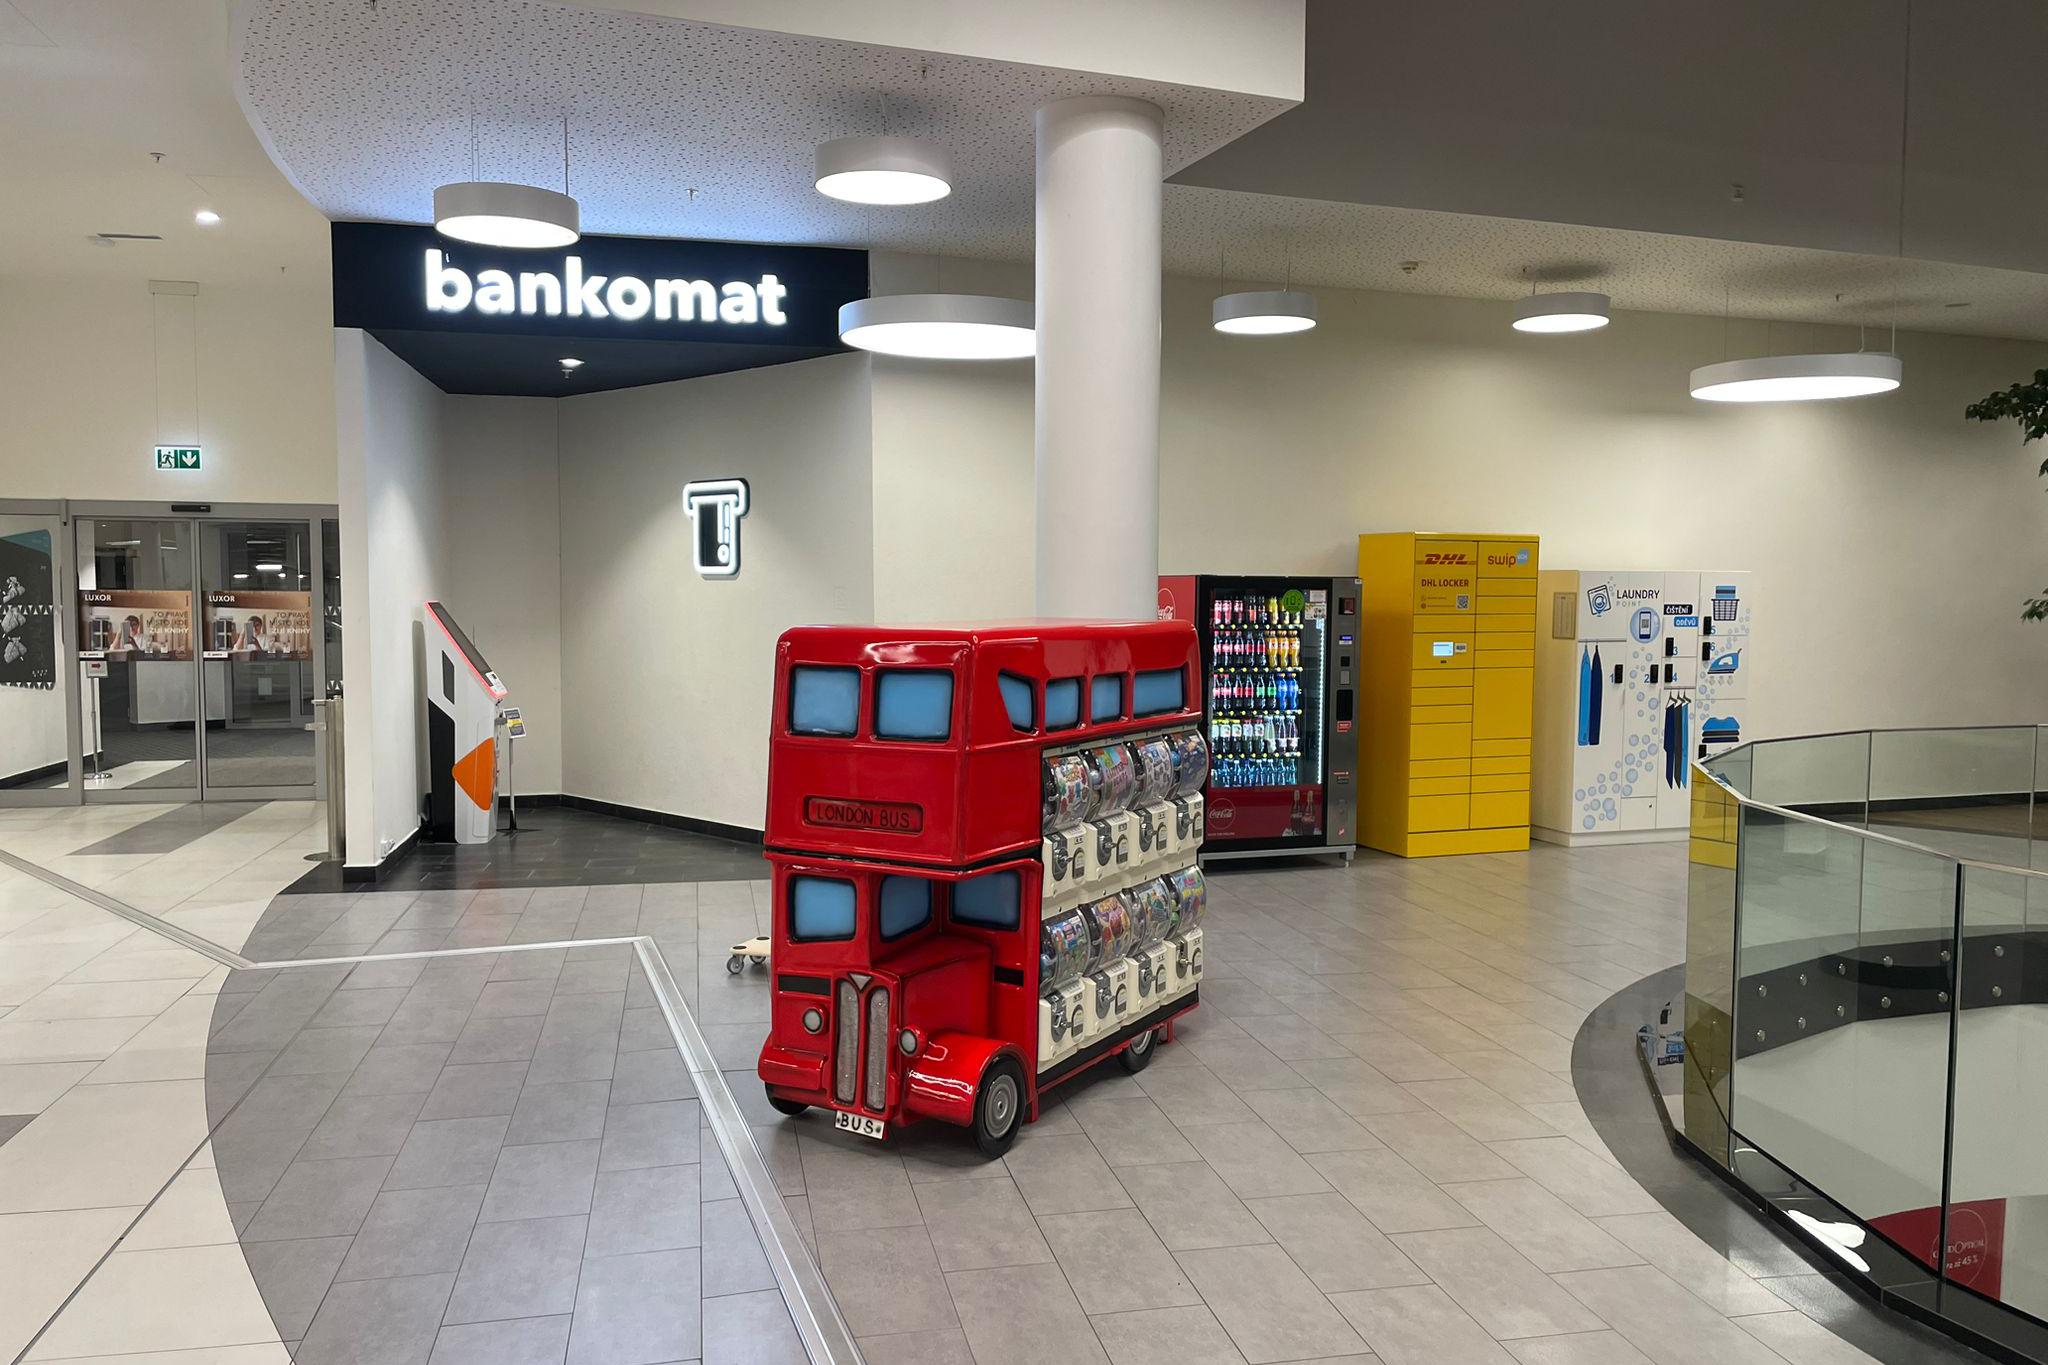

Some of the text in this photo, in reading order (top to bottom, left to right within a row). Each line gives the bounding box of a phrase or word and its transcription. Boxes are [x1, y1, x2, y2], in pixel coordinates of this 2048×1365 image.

[425, 248, 788, 325] bankomat
[1424, 553, 1468, 565] DHL
[1421, 578, 1469, 587] DHL LOCKER
[84, 593, 112, 602] LUXOR
[208, 594, 235, 603] LUXOR
[1616, 589, 1660, 600] LAUNDRY
[1644, 674, 1650, 683] 2
[816, 804, 910, 828] LONDON BUS
[840, 1113, 874, 1134] BUS
